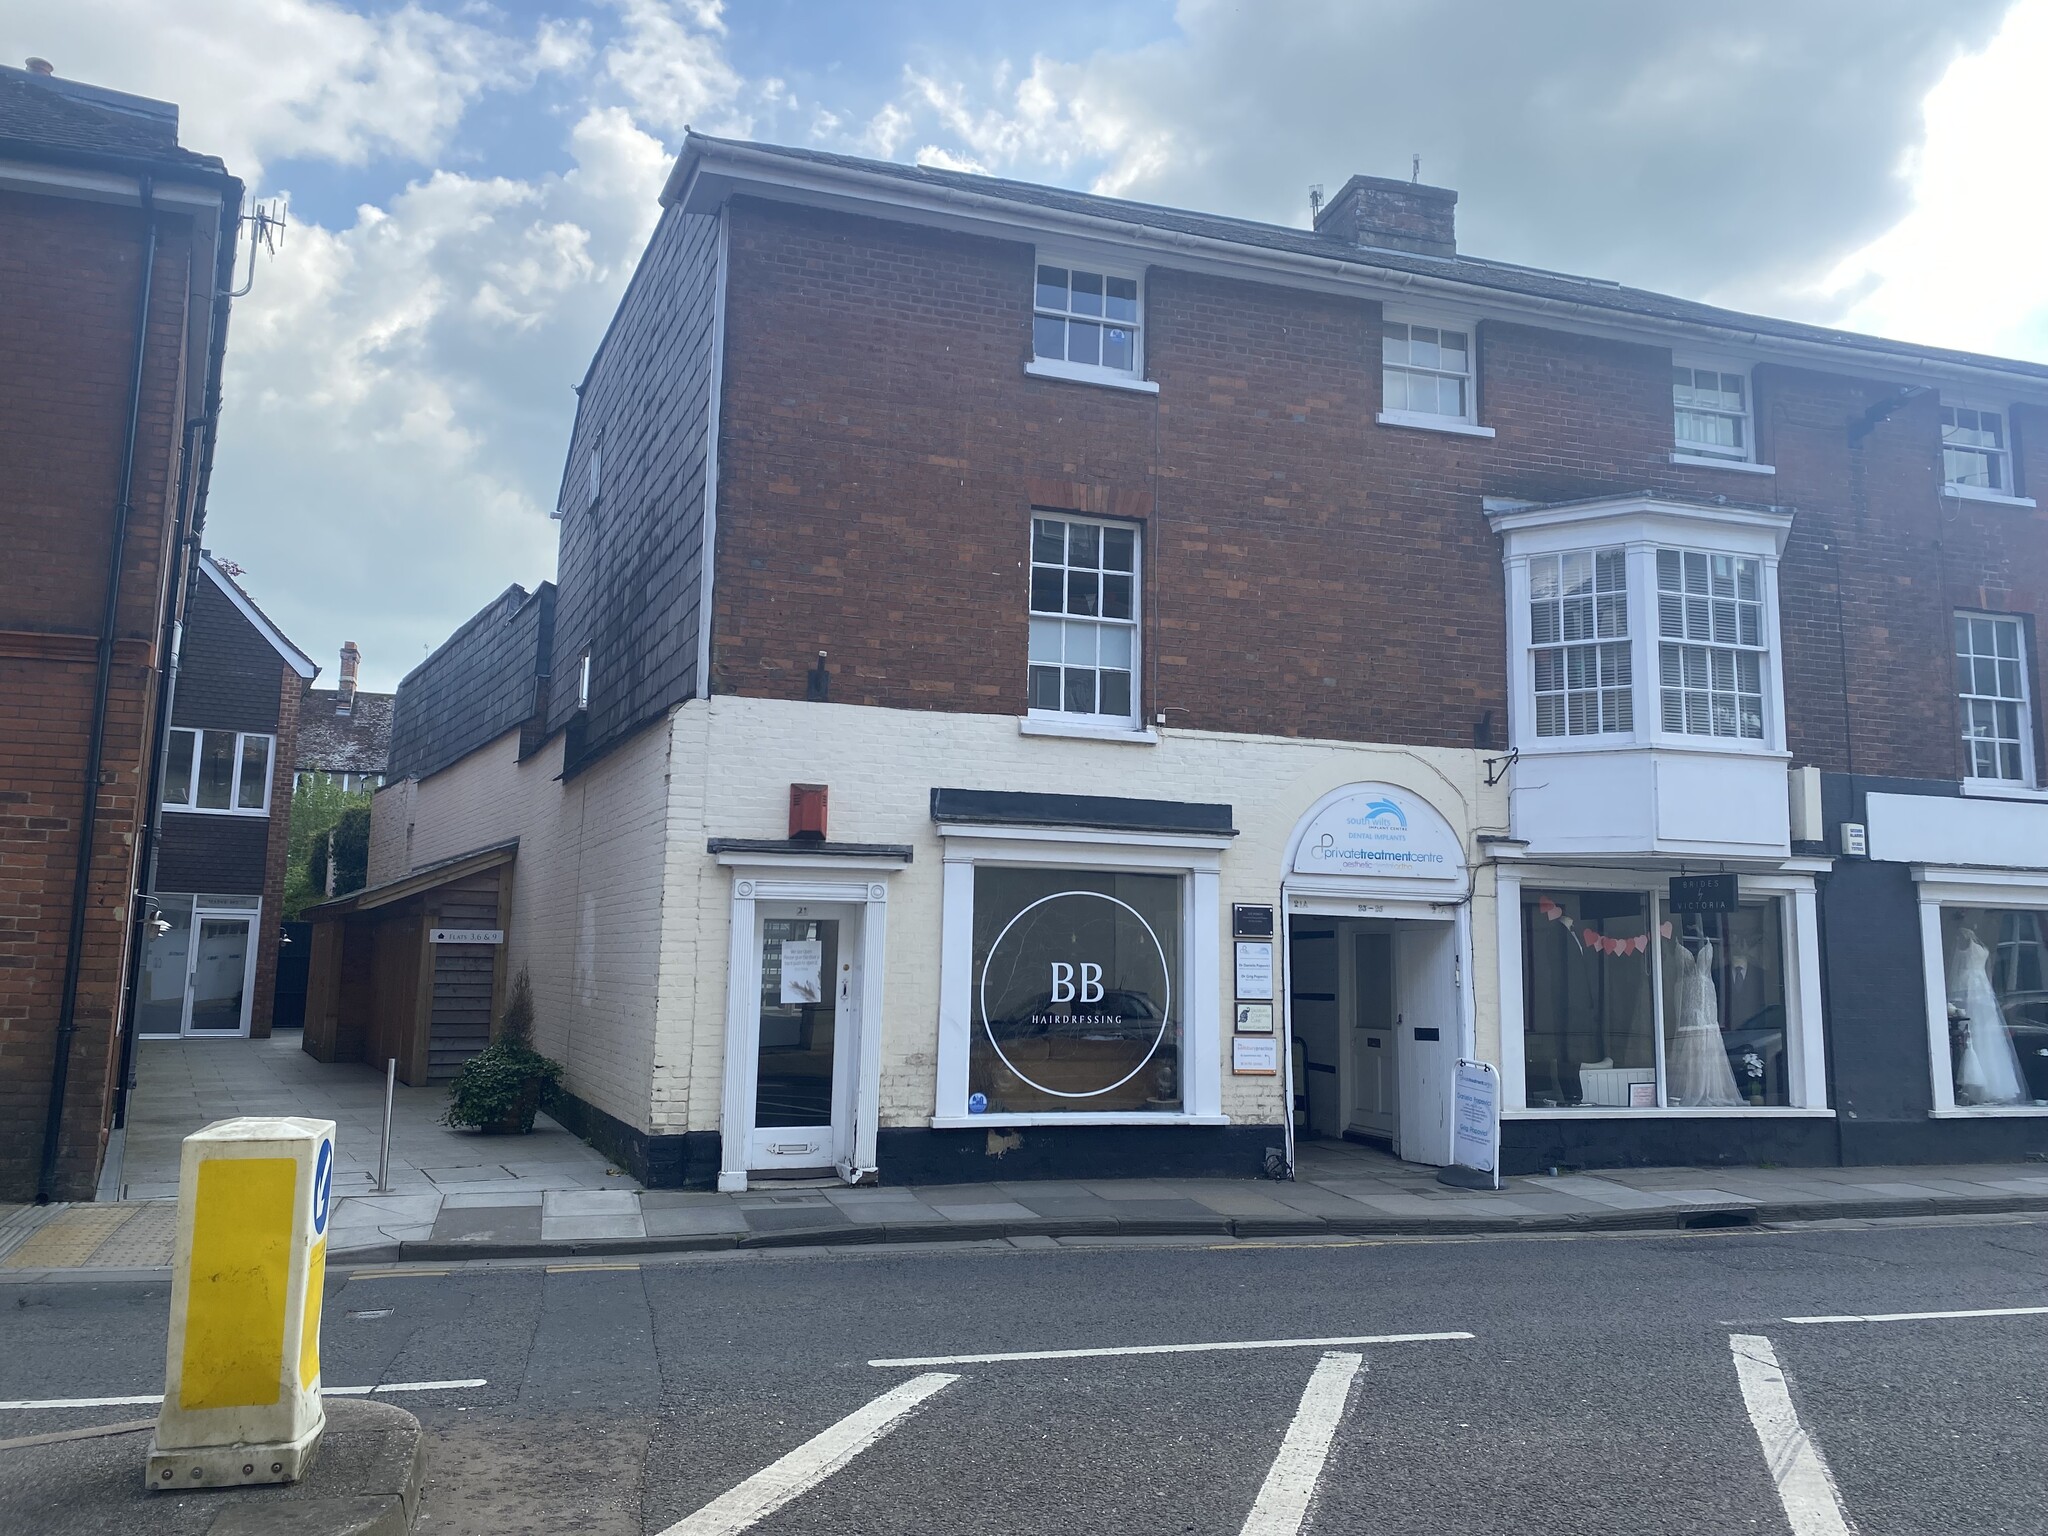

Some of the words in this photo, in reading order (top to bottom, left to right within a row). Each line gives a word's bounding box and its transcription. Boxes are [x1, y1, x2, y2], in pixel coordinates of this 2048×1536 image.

[1346, 816, 1370, 825] south
[1372, 817, 1391, 826] wilts
[1348, 832, 1372, 840] DENTAL
[1374, 833, 1406, 841] IMPLANTS
[1682, 880, 1719, 888] BRIDES
[1677, 901, 1726, 910] VICTORIA
[797, 906, 808, 915] 21
[1050, 962, 1105, 1003] BB
